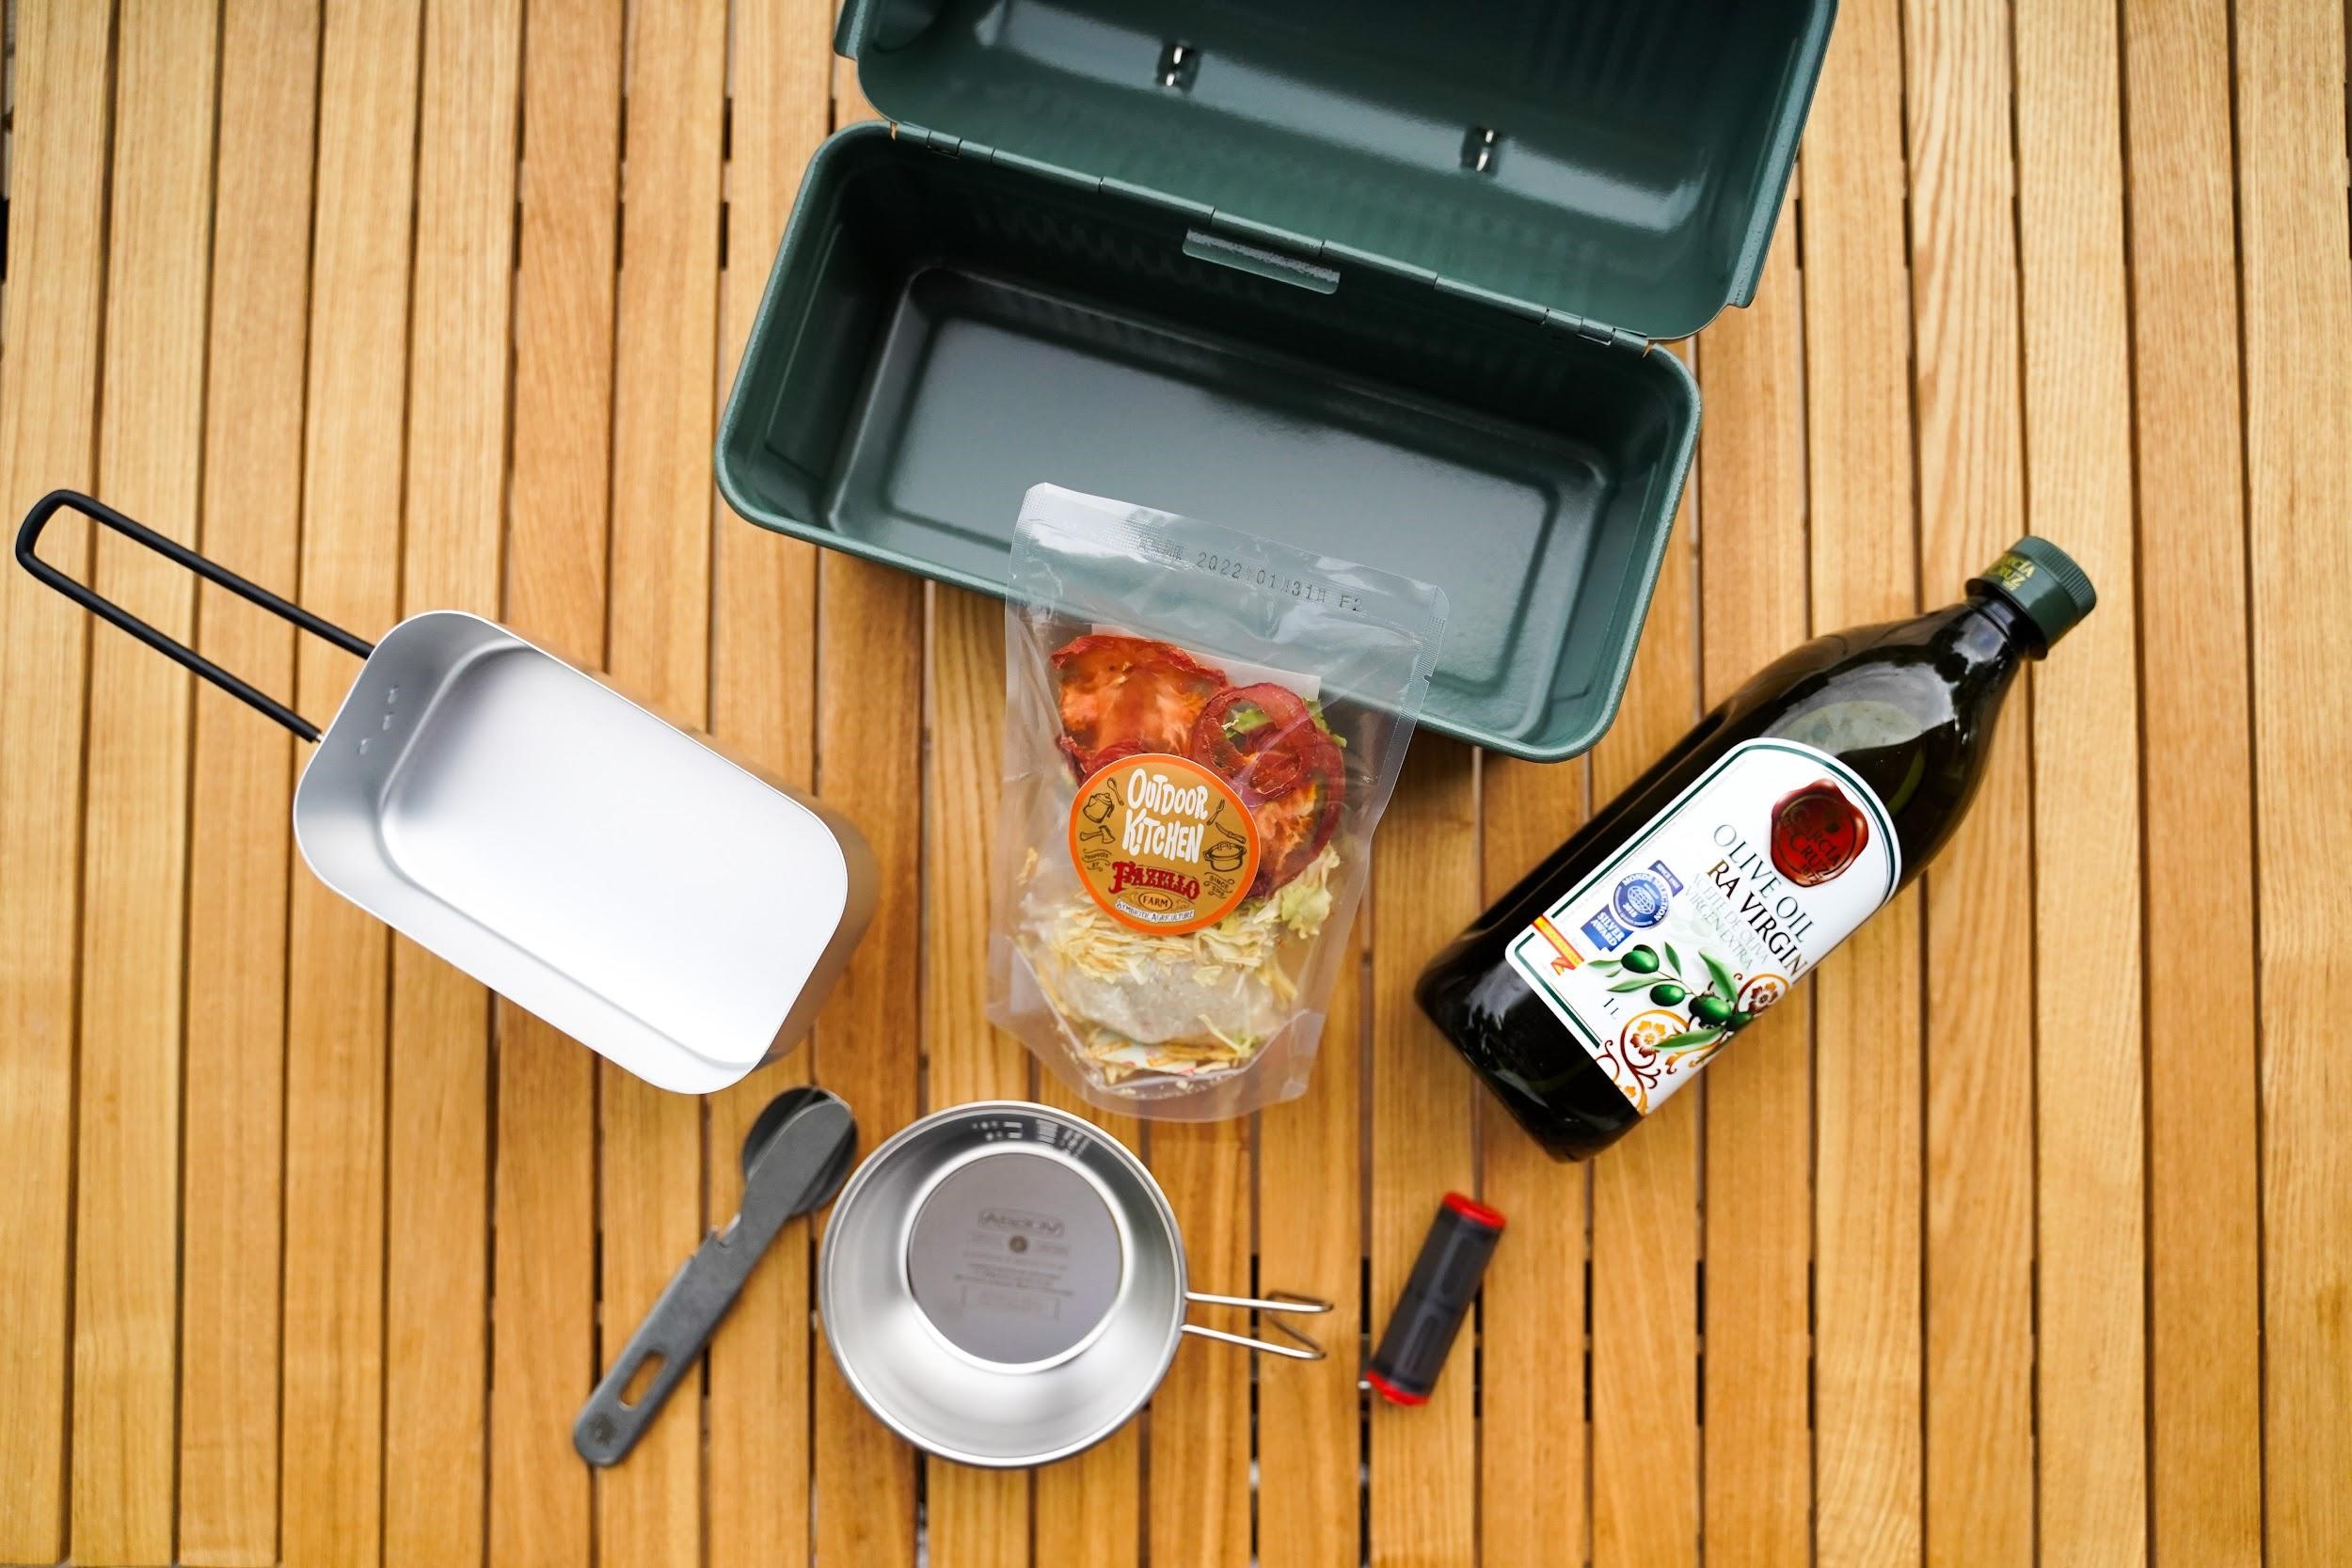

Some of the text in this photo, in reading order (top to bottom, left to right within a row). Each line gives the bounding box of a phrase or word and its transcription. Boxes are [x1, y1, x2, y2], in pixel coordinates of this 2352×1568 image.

[1127, 768, 1209, 820] OUTDOOR
[1121, 807, 1204, 864] KITCHEN
[1142, 895, 1168, 908] FARM
[1209, 875, 1229, 890] SINCE
[1713, 824, 1782, 899] OLIVE
[1775, 895, 1815, 943] OIL
[1590, 919, 1618, 946] AWARD
[1597, 911, 1626, 942] SILVER
[1724, 911, 1742, 927] DE
[1740, 928, 1769, 965] OLIVA
[1740, 891, 1807, 977] VIRGIN
